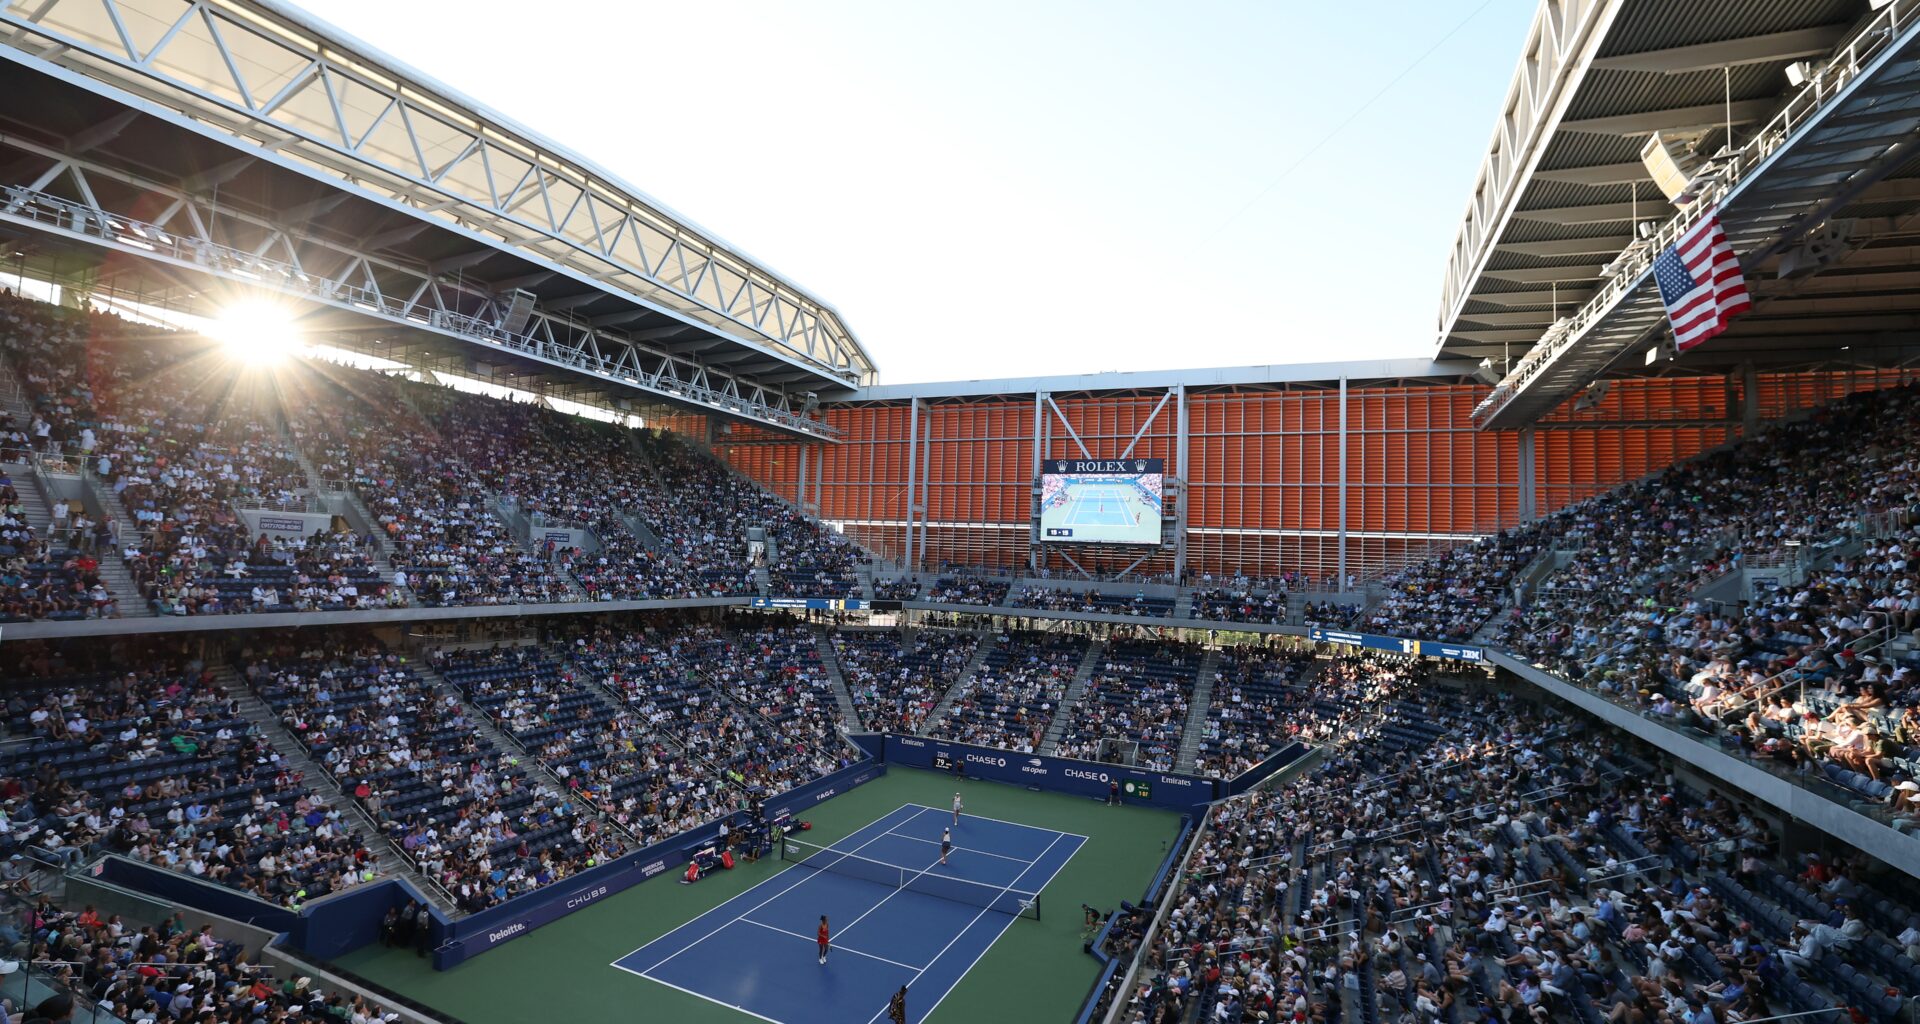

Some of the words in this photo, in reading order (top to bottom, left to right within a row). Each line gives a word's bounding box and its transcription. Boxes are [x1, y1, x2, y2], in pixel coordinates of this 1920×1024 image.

[1075, 461, 1126, 472] ROLEX
[1462, 649, 1480, 660] IBM
[901, 738, 925, 748] Emirates
[937, 751, 950, 759] IBM
[966, 754, 997, 765] CHASE
[936, 758, 945, 766] 79
[1030, 767, 1048, 775] open
[1064, 768, 1098, 781] CHASE
[1161, 775, 1192, 787] Emirates
[816, 788, 835, 801] FAGE
[641, 860, 664, 873] AMERICAN
[645, 865, 666, 877] EXPRESS
[567, 886, 607, 908] CHUBB
[489, 923, 525, 943] Deloitte.
